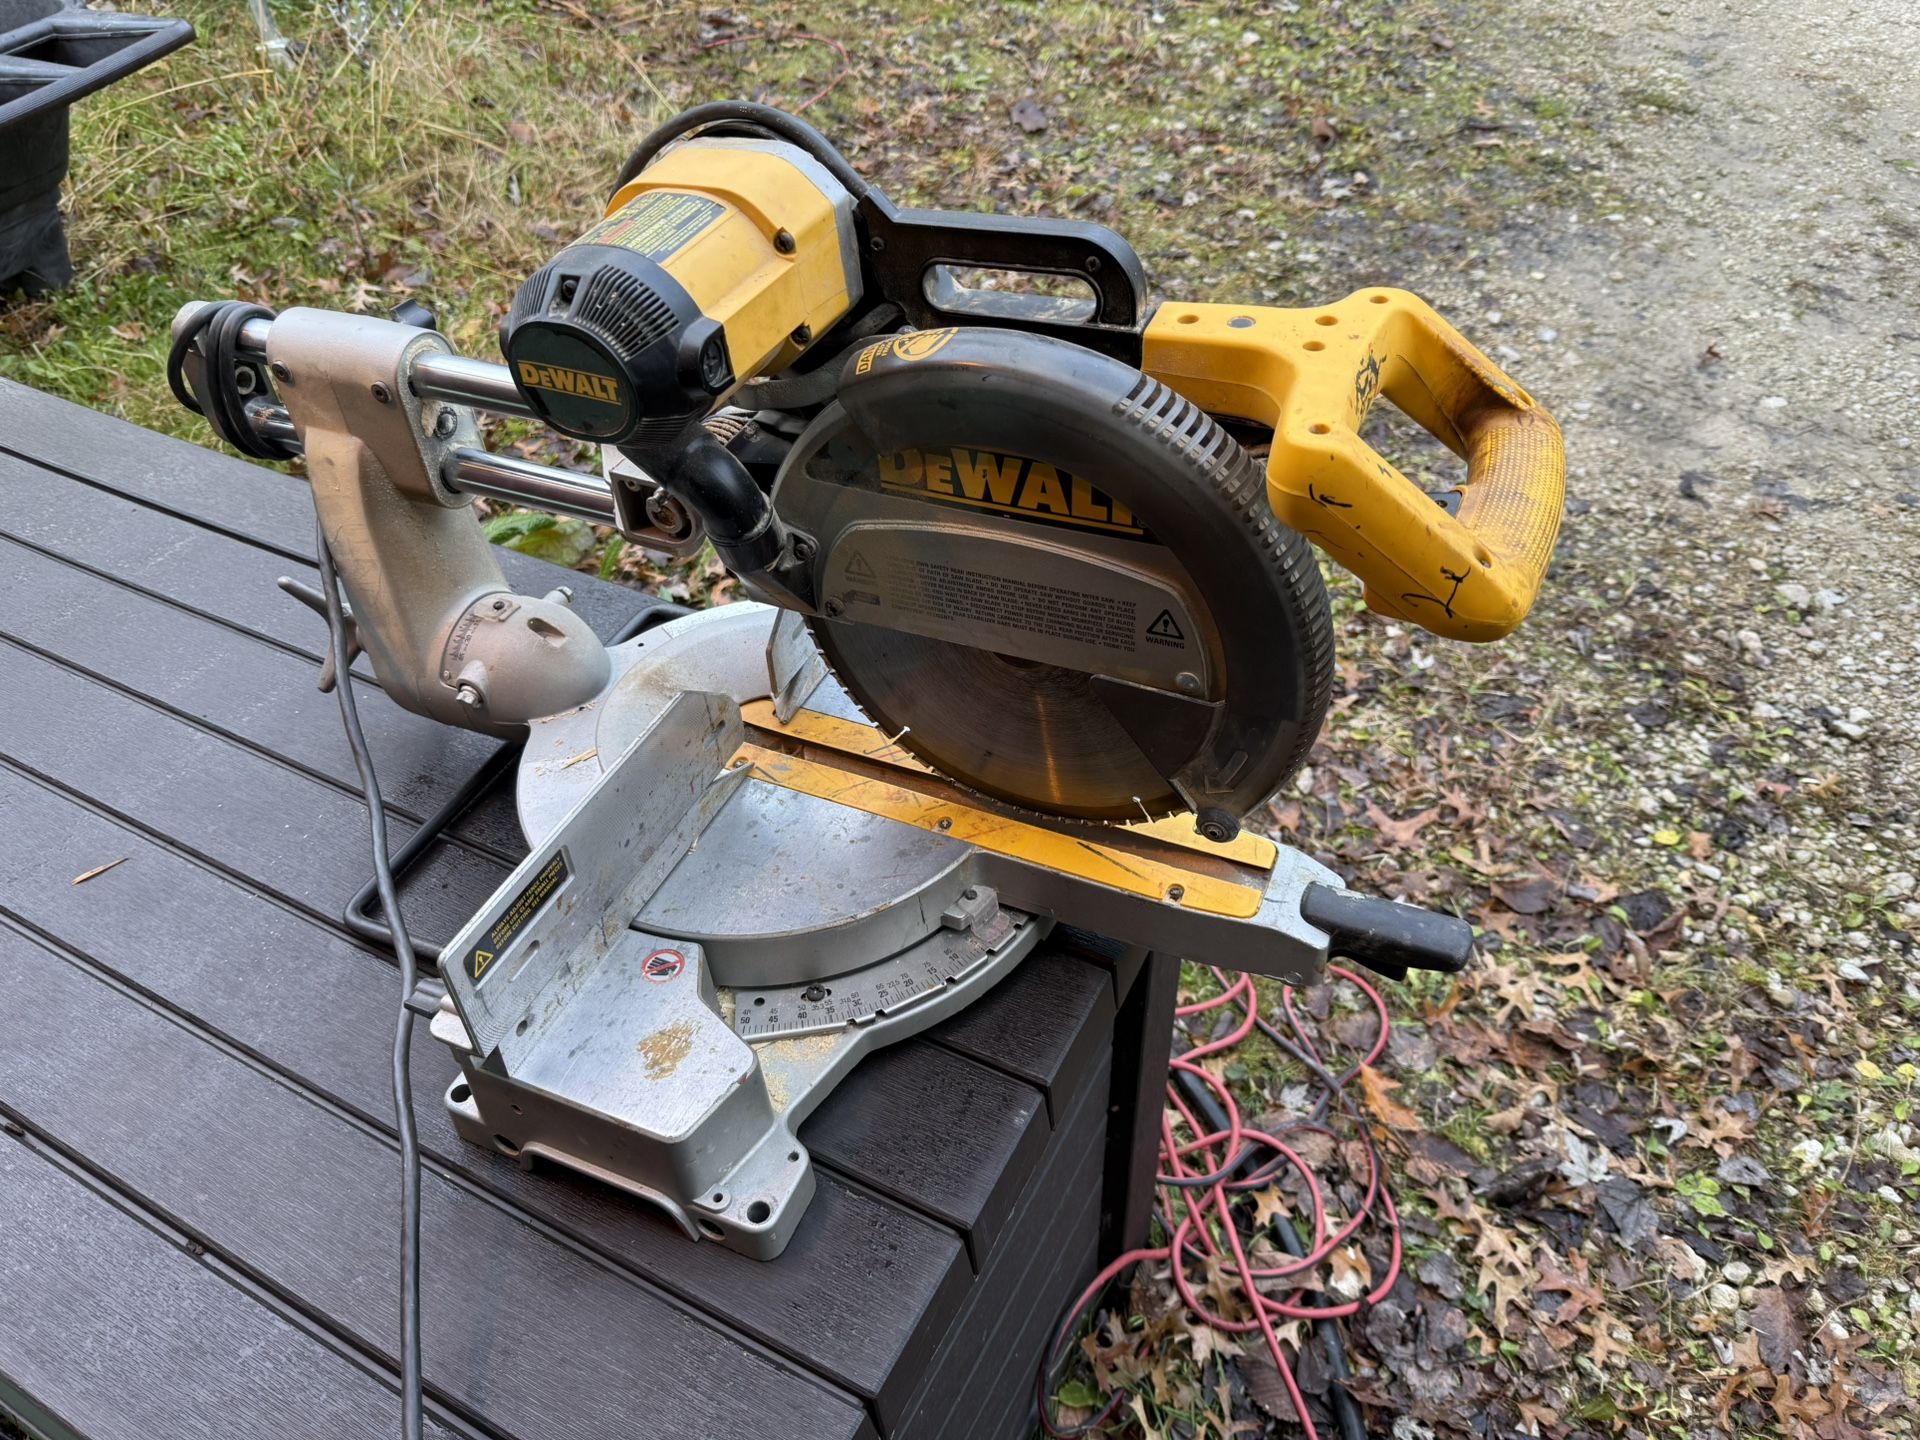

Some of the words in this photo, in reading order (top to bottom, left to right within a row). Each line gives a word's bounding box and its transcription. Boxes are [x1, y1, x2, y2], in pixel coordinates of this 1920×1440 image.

[930, 563, 948, 571] SAFETY
[966, 570, 1001, 581] INSTRUCTION
[1002, 577, 1025, 586] MANUAL
[1027, 582, 1046, 590] BEFORE
[1049, 586, 1079, 596] OPERATING
[1013, 586, 1037, 595] OPERATE
[1055, 594, 1080, 603] WITHOUT
[939, 578, 973, 589] ADJUSTMENT
[975, 585, 993, 593] KNOBS
[996, 589, 1015, 597] BEFORE
[1061, 602, 1086, 611] PERFORM
[1103, 610, 1135, 620] OPERATION
[970, 602, 1002, 613] DISCONNECT
[1046, 618, 1073, 627] CHANGING
[974, 609, 995, 617] RETURN
[1074, 629, 1100, 639] POSITION
[1047, 612, 1069, 620] MOVING
[1105, 623, 1135, 633] CHANGING
[1088, 613, 1105, 621] FRONT
[1145, 636, 1184, 650] WARNING
[492, 914, 510, 938] ALWAYS
[510, 896, 526, 916] ADJUST
[526, 880, 539, 896] FENCE
[540, 857, 560, 880] PROPERLY
[493, 925, 510, 944] BEFORE
[520, 895, 535, 913] CLAMP
[535, 879, 549, 895] SMALL
[496, 931, 511, 950] BEFORE
[531, 897, 540, 908] SEE
[825, 1006, 835, 1014] 35
[878, 989, 888, 998] 25
[904, 978, 914, 987] 20
[927, 967, 937, 975] 15
[949, 953, 959, 961] 10
